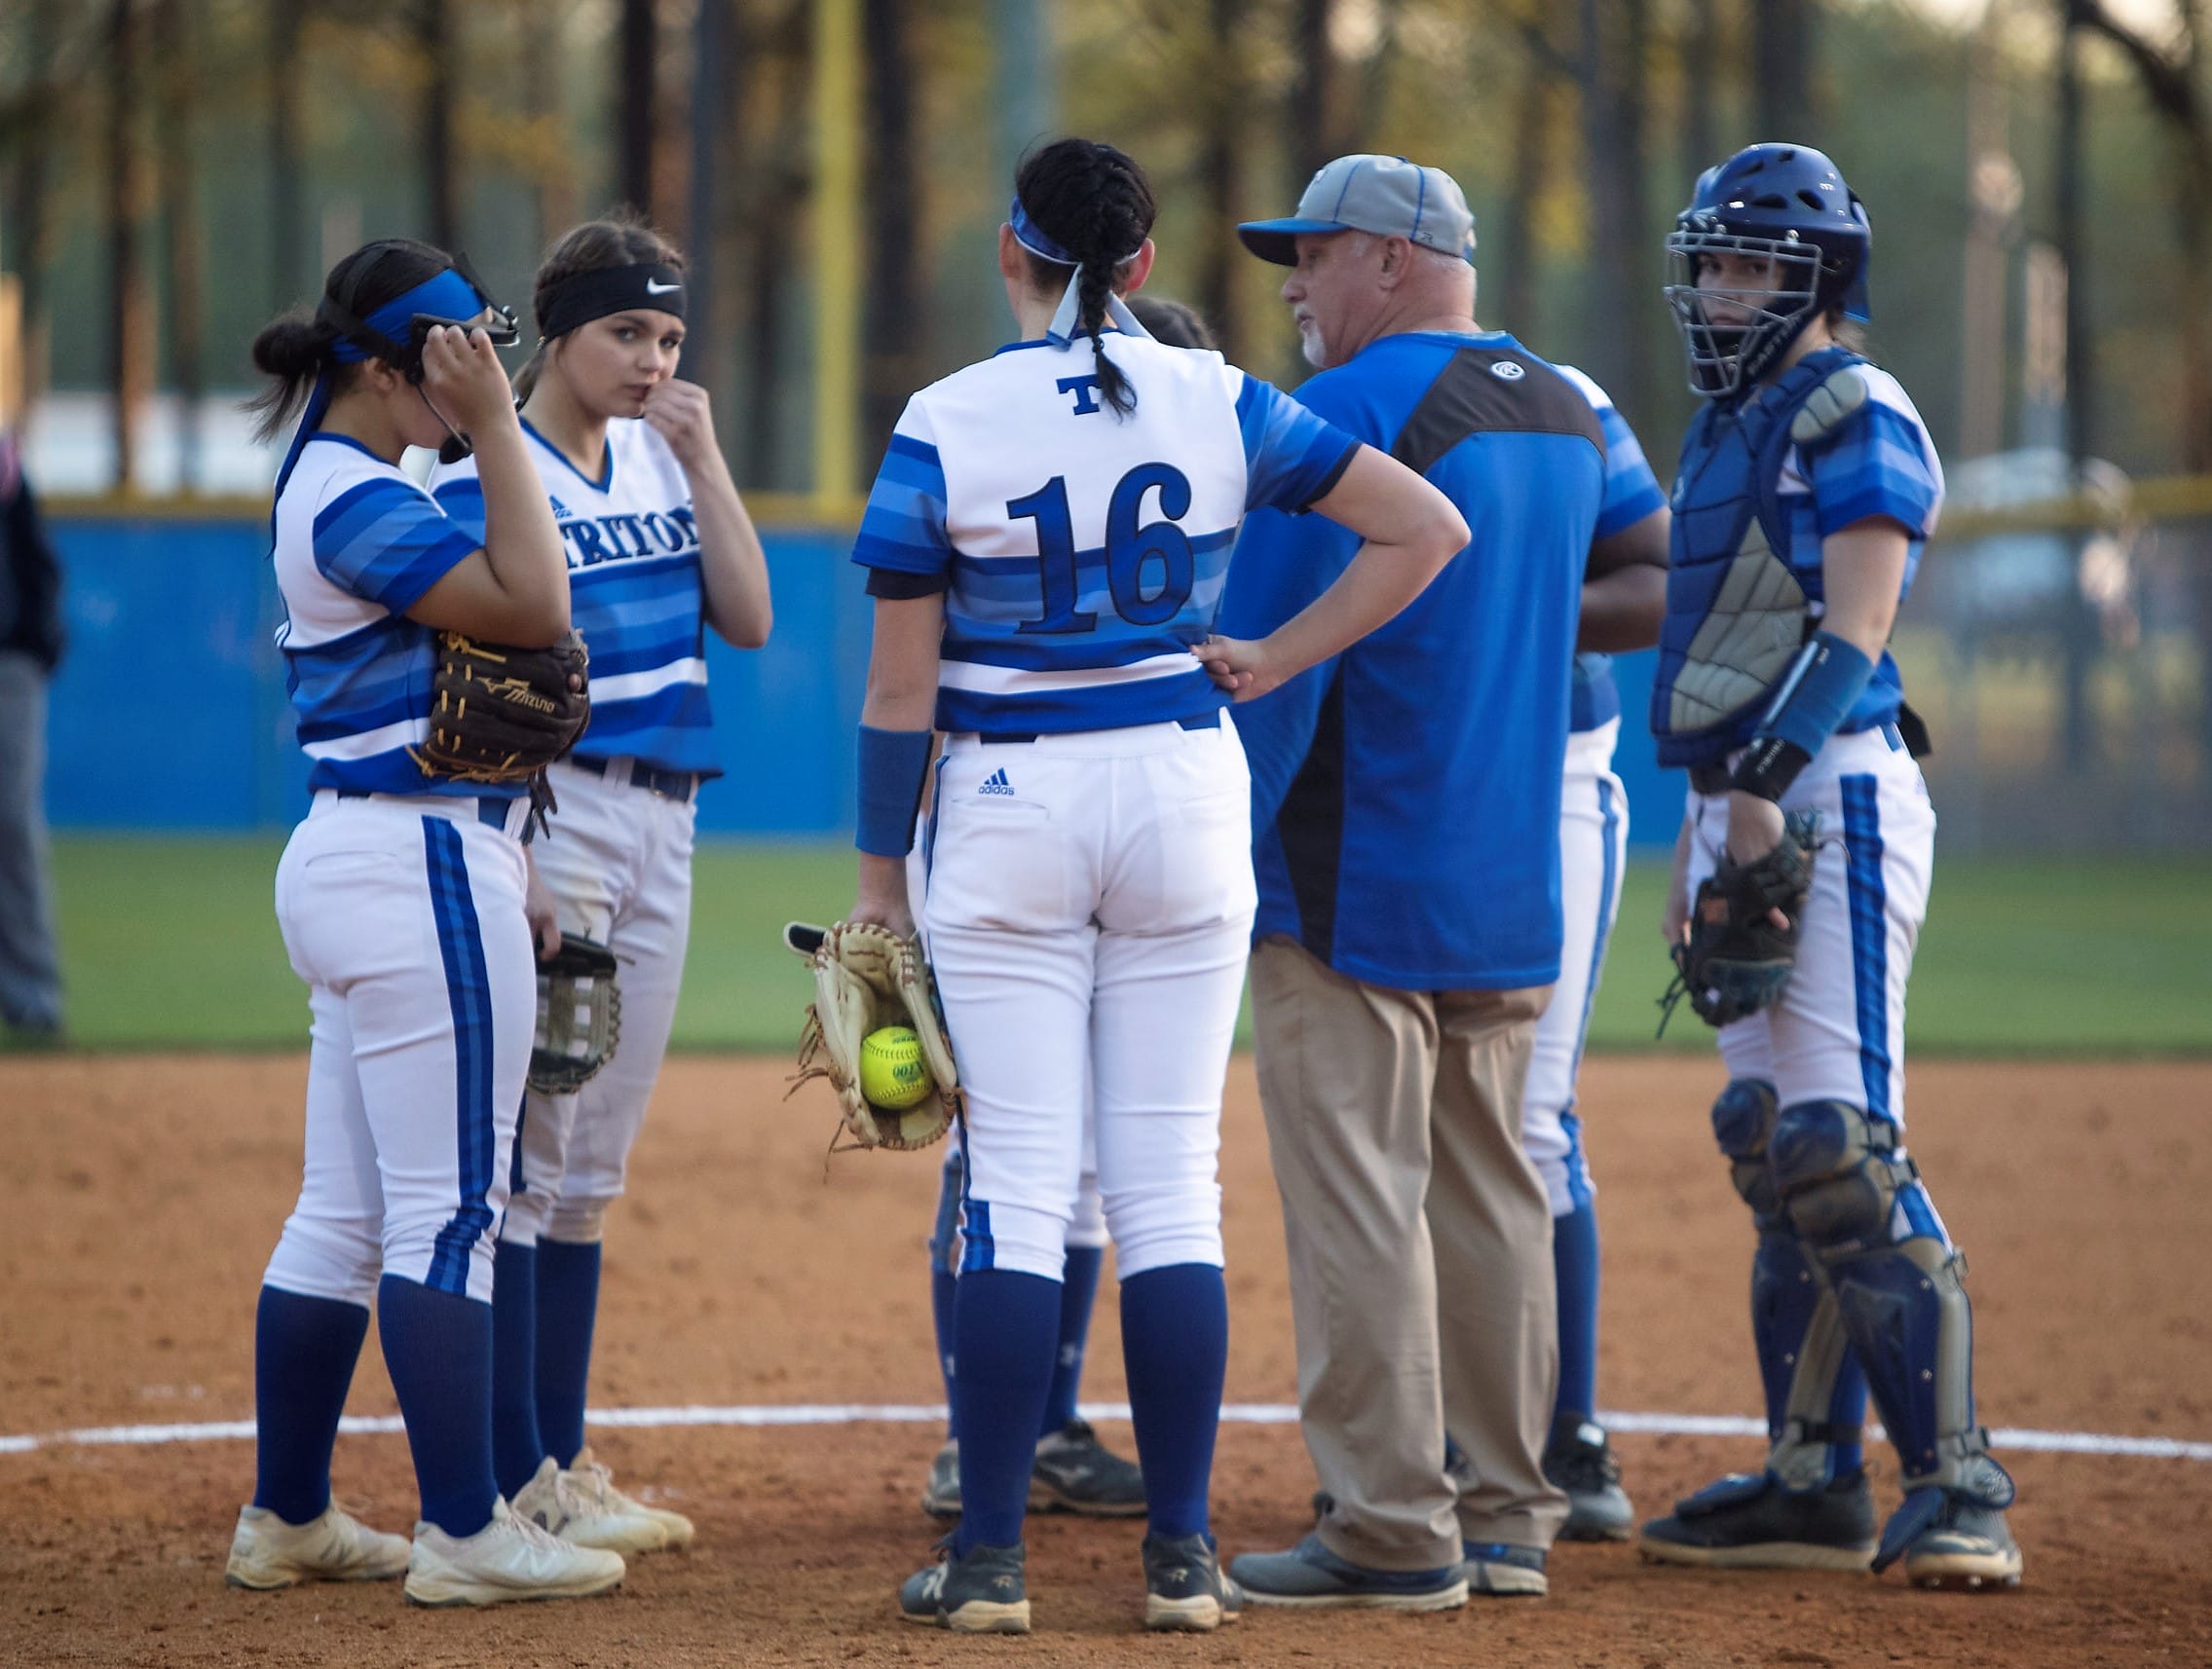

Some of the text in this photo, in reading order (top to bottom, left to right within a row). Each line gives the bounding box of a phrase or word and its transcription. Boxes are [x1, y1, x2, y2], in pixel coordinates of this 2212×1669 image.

[1056, 374, 1104, 416] T
[1006, 462, 1194, 634] 16
[978, 783, 1015, 796] adidas
